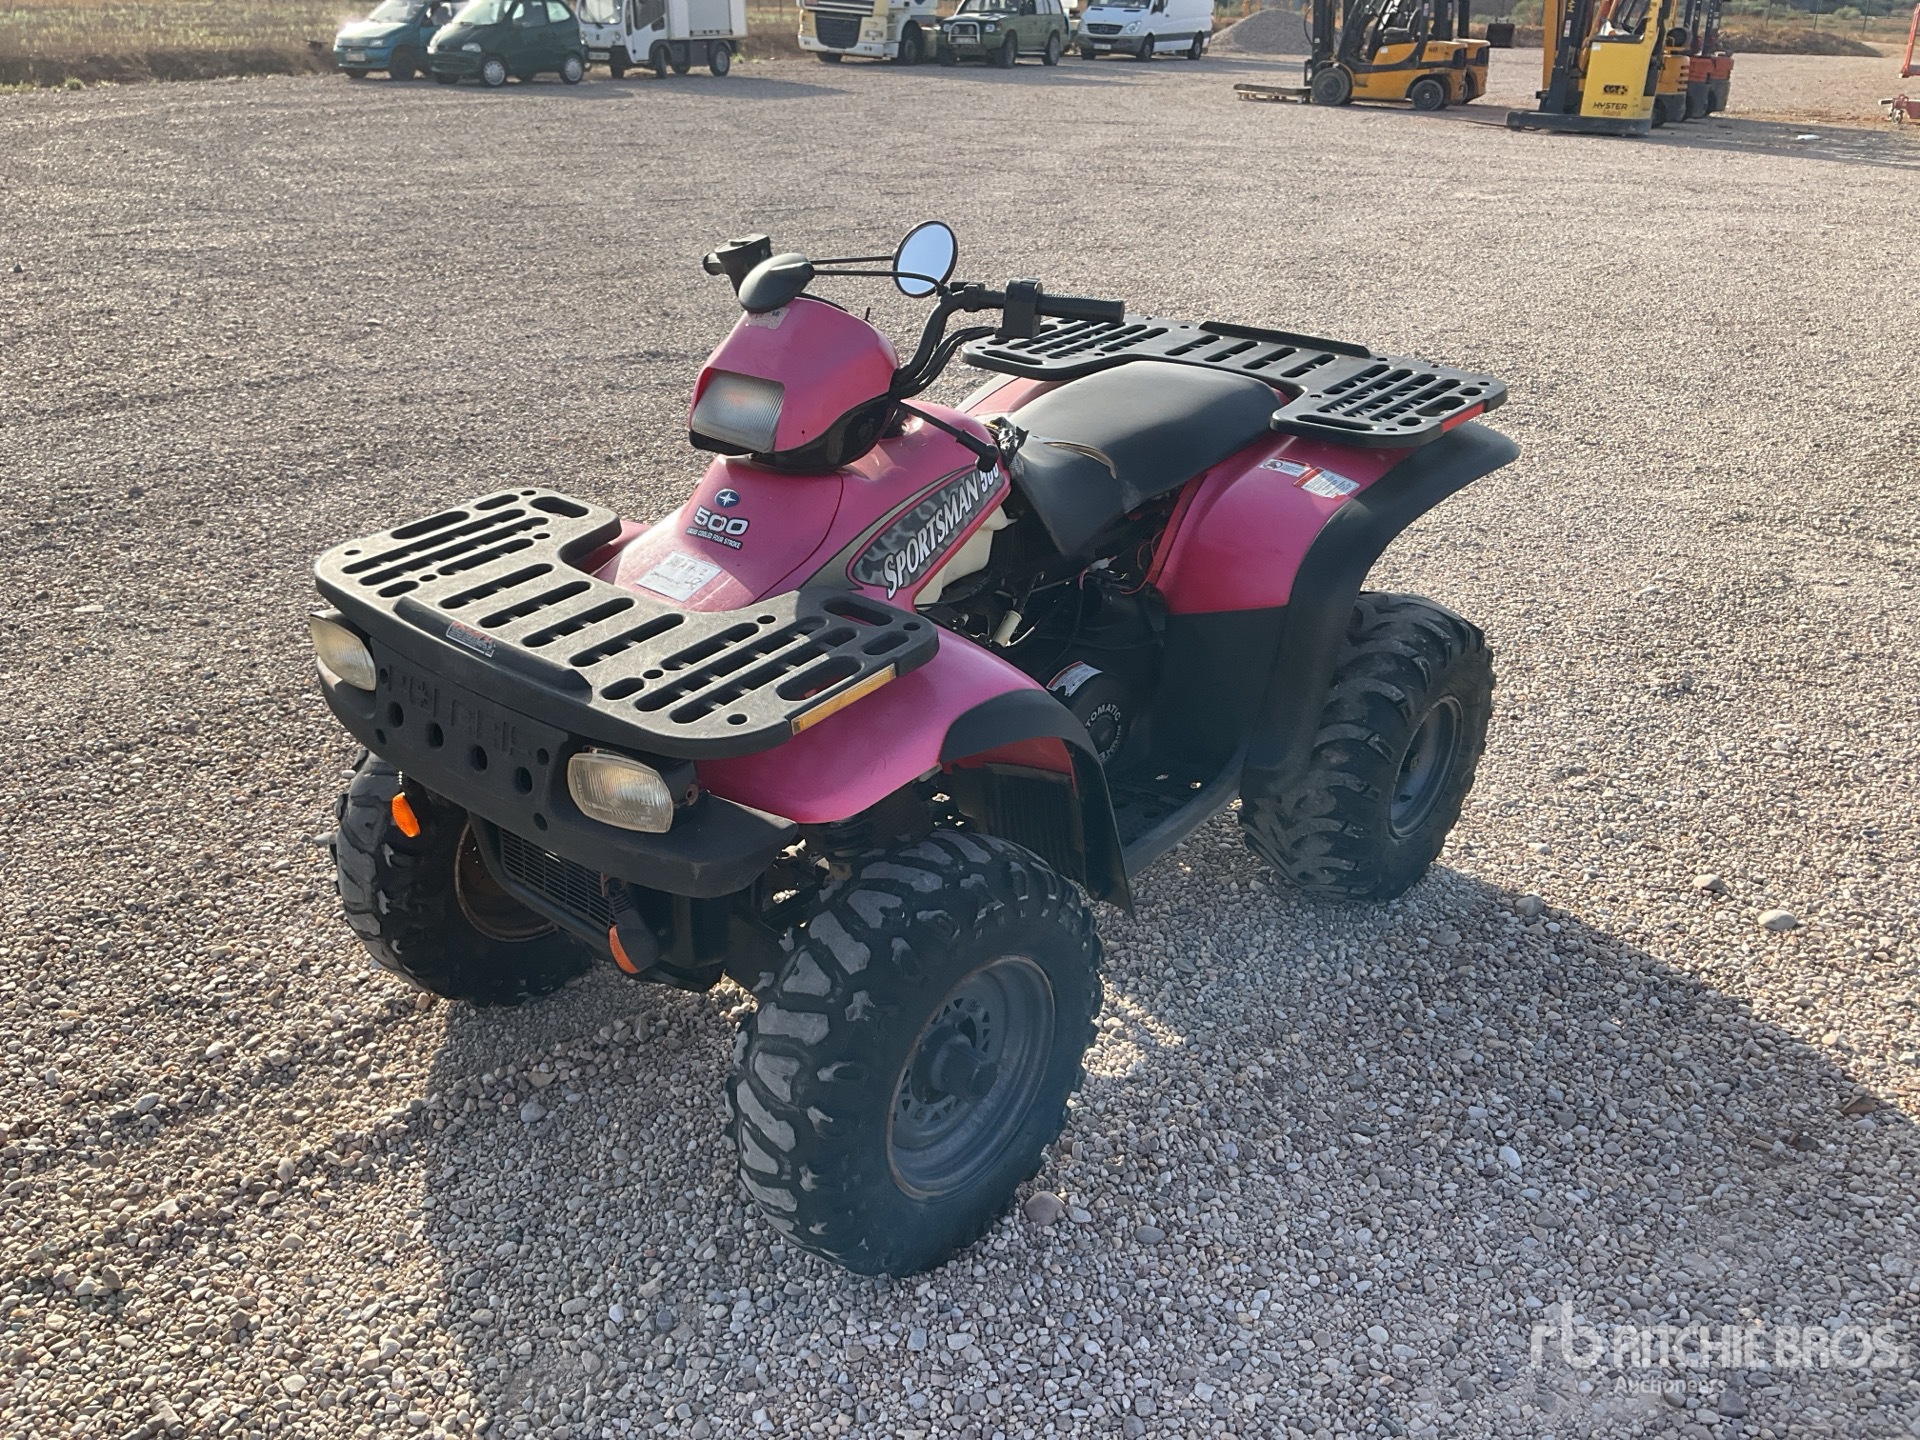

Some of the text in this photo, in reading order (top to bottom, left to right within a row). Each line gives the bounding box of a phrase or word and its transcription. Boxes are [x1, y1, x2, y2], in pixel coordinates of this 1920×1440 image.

[1593, 102, 1628, 110] HYSTER
[694, 506, 749, 535] 500
[884, 472, 979, 599] SPORTSMAN
[1085, 704, 1121, 728] TOMATIC
